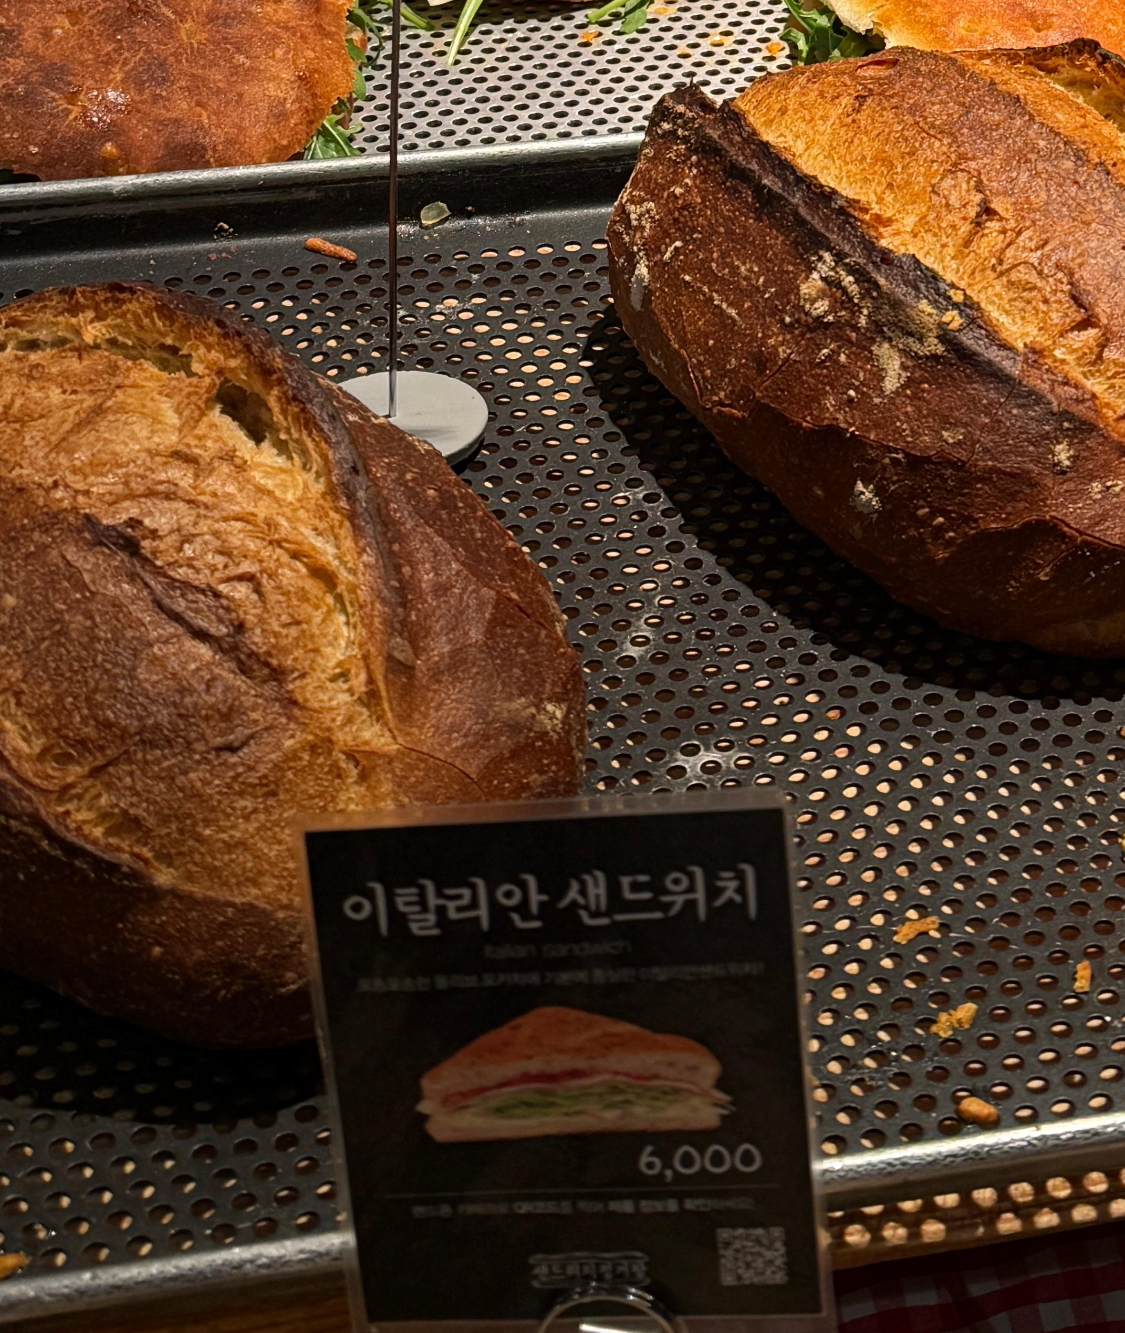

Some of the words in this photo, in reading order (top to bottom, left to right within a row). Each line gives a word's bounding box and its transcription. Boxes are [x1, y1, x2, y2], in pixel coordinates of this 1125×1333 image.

[342, 873, 550, 938] 이탈리안
[556, 863, 759, 927] 샌드위치
[638, 1142, 764, 1182] 6,000
